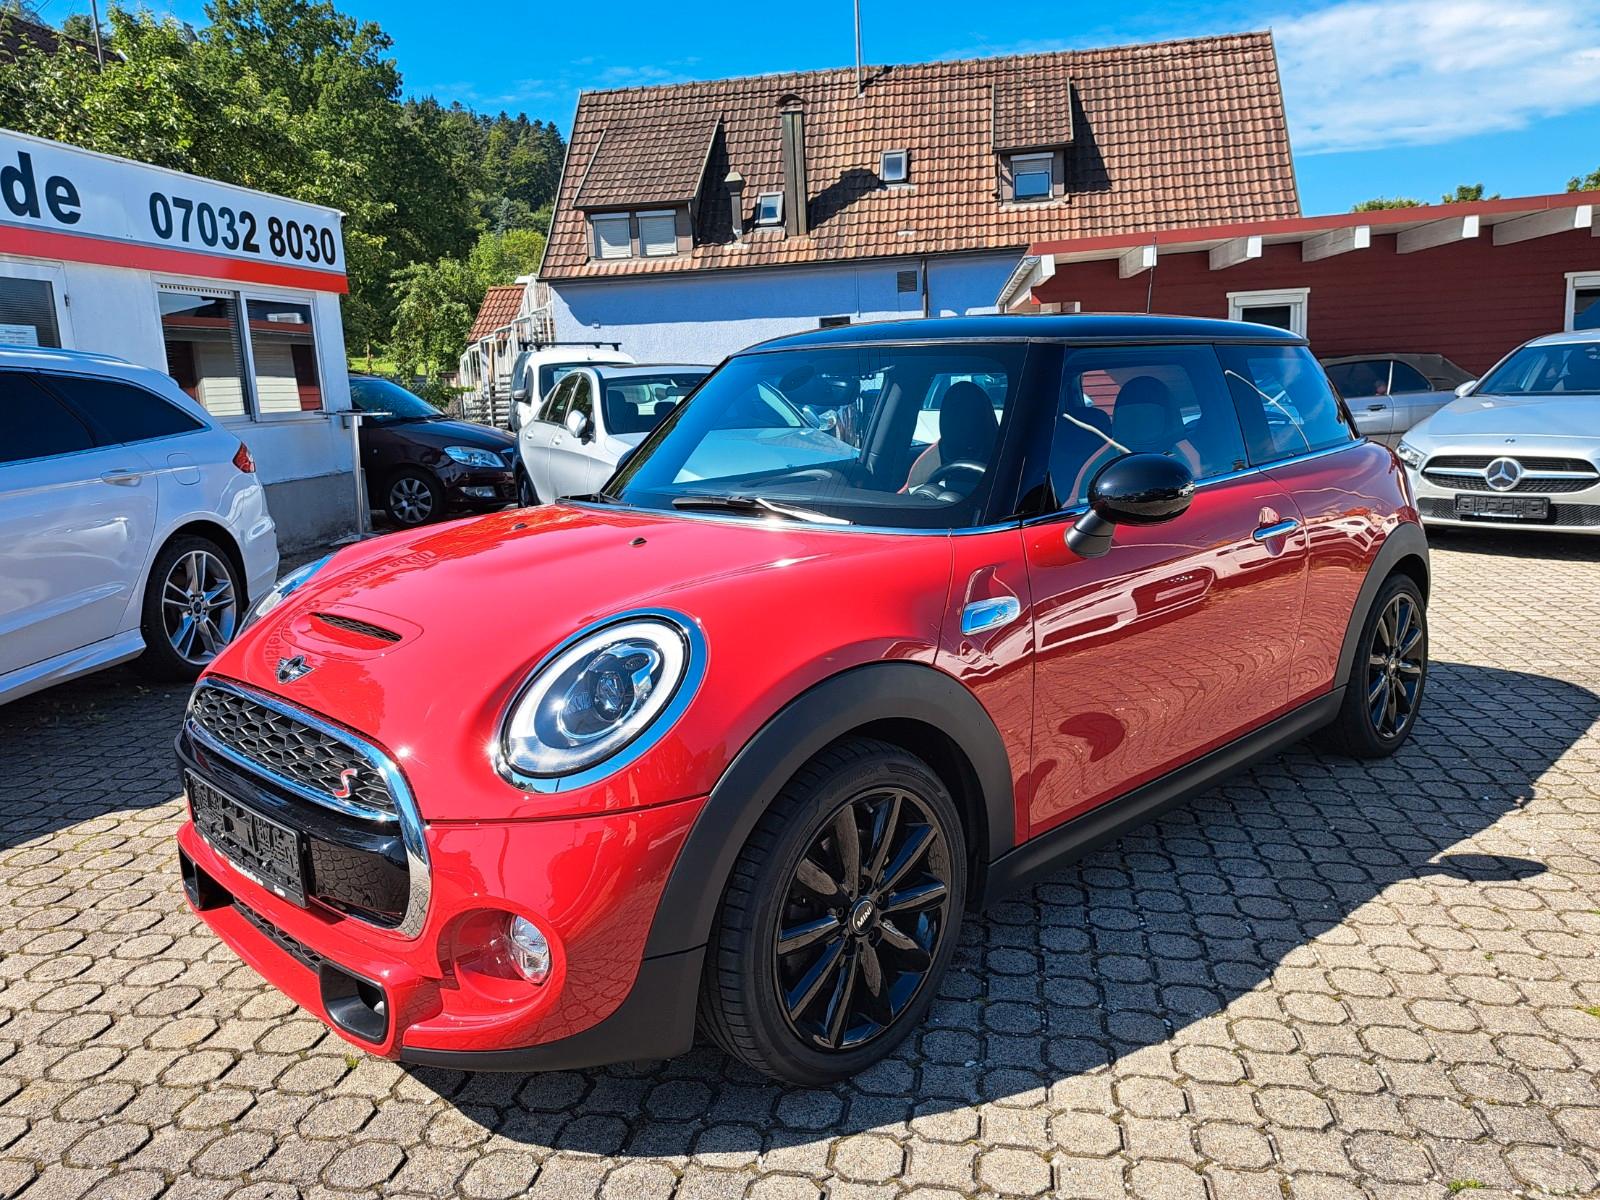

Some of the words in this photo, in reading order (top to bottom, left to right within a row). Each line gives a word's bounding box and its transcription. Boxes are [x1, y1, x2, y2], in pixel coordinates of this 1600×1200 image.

[149, 192, 260, 253] 07032
[267, 216, 336, 265] 8030
[333, 768, 358, 798] S
[857, 906, 872, 928] MINI
